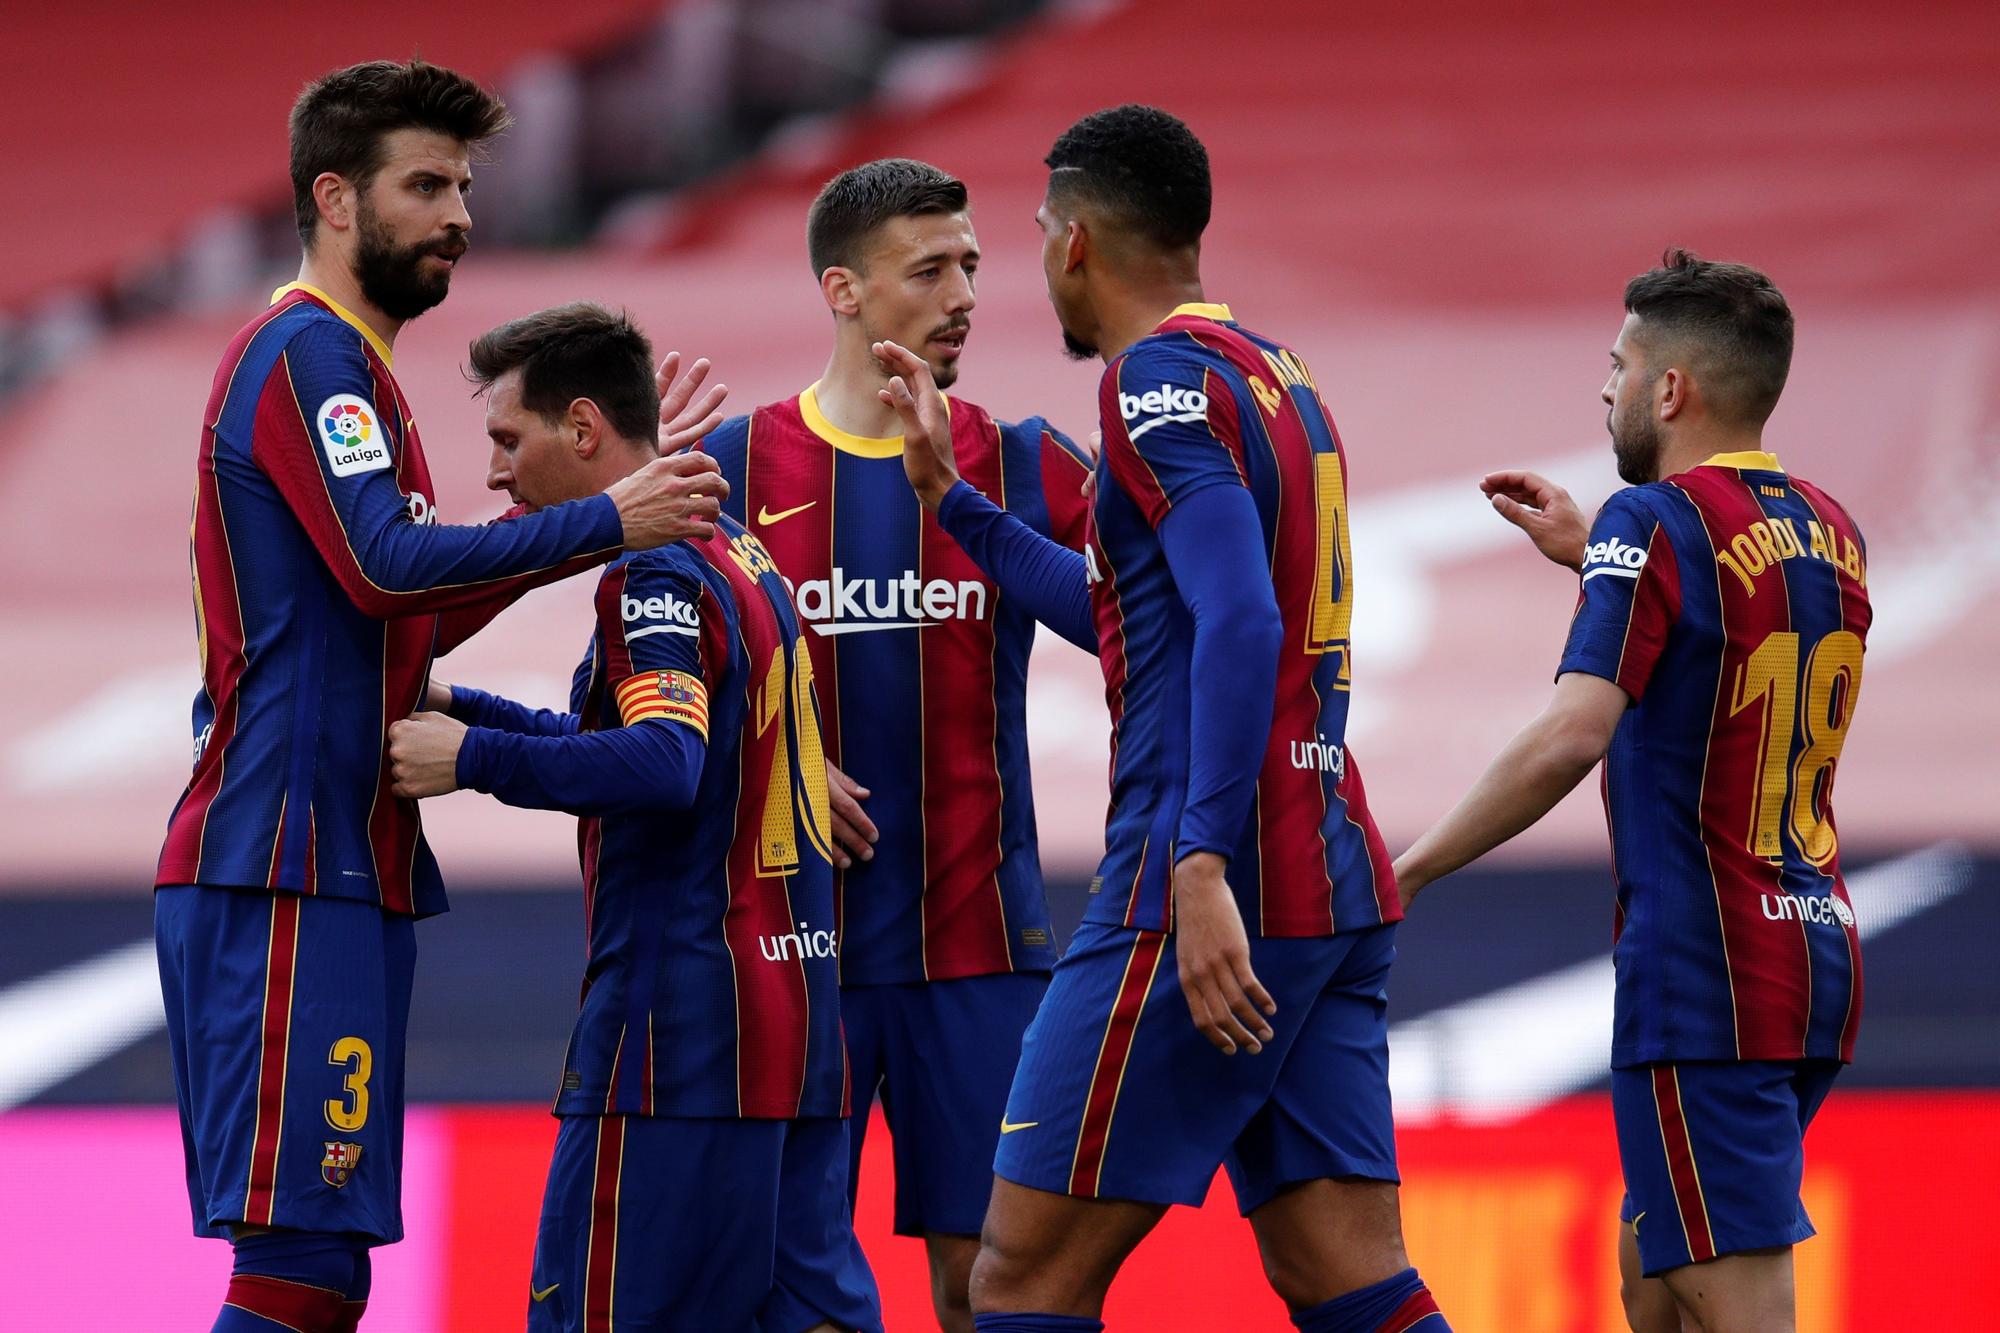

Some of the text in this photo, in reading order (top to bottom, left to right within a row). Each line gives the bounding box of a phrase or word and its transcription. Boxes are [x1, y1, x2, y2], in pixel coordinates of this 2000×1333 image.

[1119, 384, 1209, 420] beko
[335, 449, 383, 466] LaLiga
[1716, 518, 1807, 598] JORDI
[621, 593, 700, 627] beko
[782, 567, 986, 620] akuten
[1730, 630, 1865, 867] 18
[1761, 894, 1835, 926] unice
[758, 922, 837, 961] unice
[324, 1036, 372, 1132] 3
